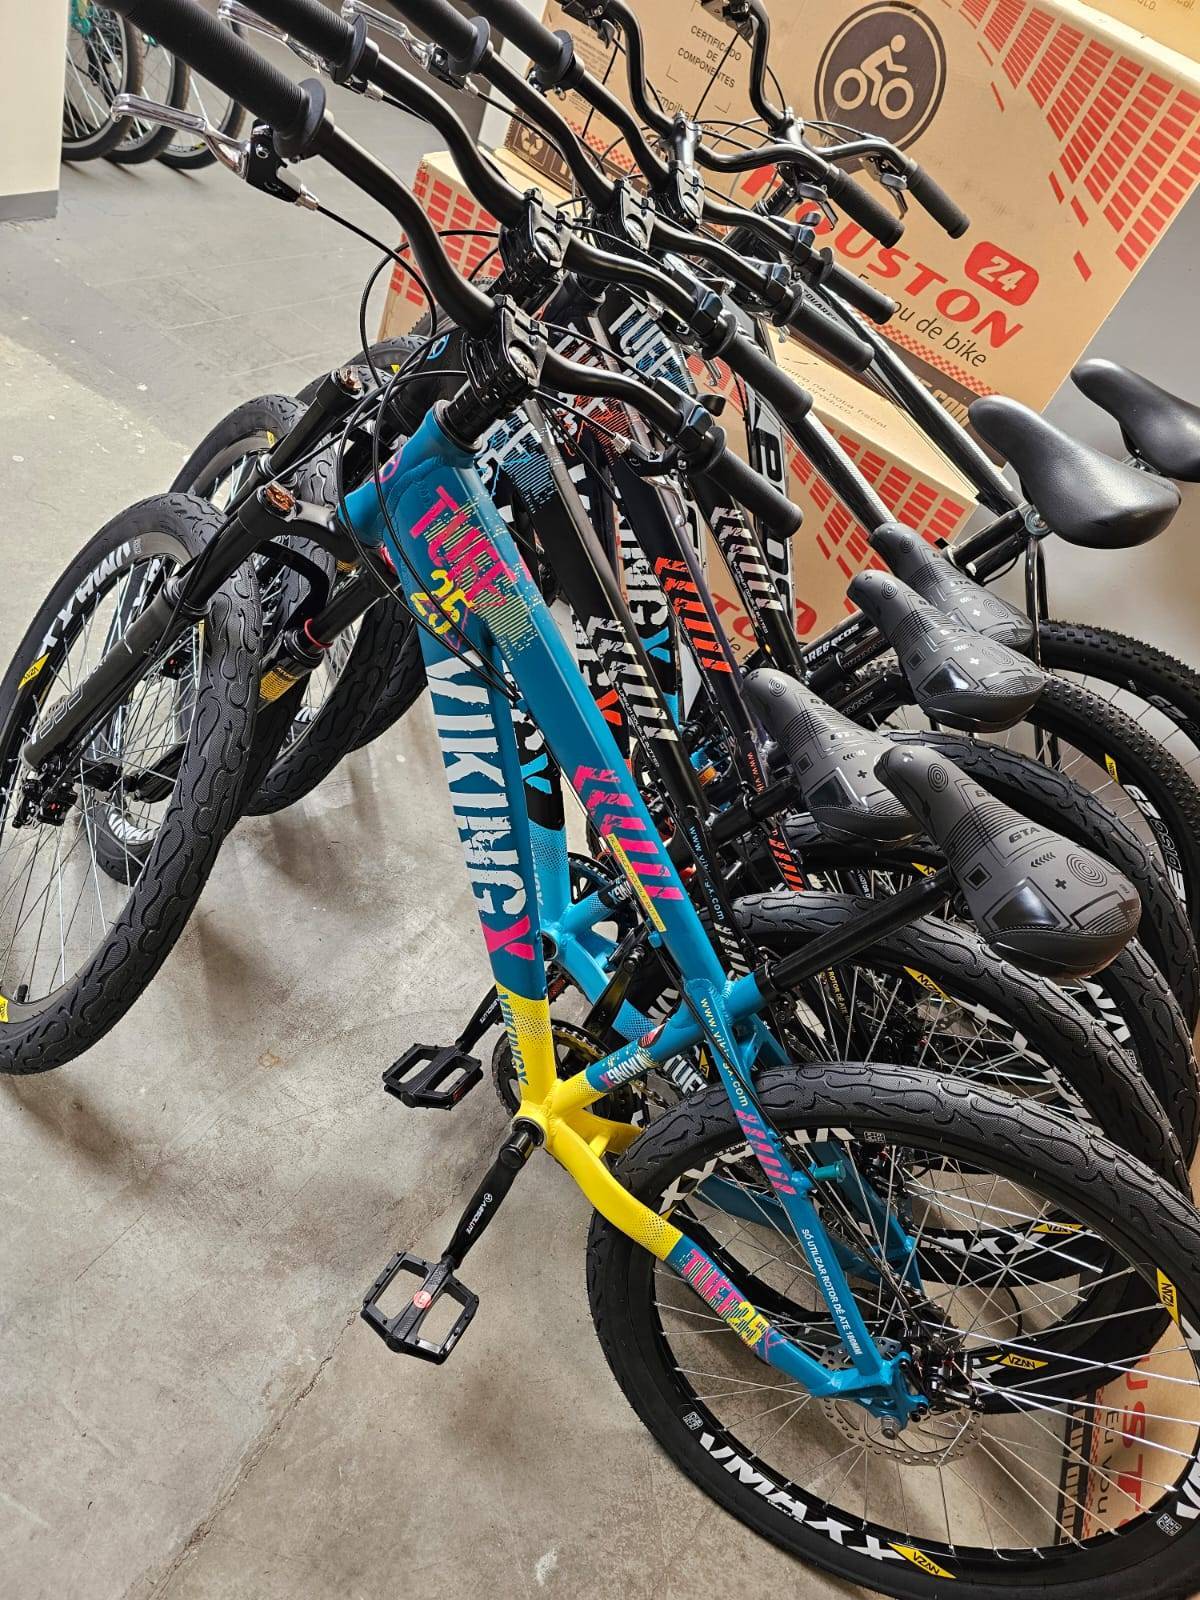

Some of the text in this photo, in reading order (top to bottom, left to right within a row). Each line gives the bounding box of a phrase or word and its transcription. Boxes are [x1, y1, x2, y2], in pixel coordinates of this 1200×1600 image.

[690, 25, 743, 62] CERTIFICDO
[705, 49, 719, 62] DE
[977, 255, 1028, 292] 24
[915, 313, 943, 340] de
[943, 328, 987, 368] bike
[410, 485, 517, 604] TUFF
[37, 541, 131, 660] VMAXX
[410, 569, 475, 635] 25
[427, 650, 535, 960] VIKINGX
[1123, 784, 1161, 820] 29
[1009, 826, 1041, 844] GTA
[683, 1248, 747, 1313] TUFF
[806, 1240, 828, 1274] UTILIZAR
[820, 1274, 839, 1302] ROTOR
[1008, 1356, 1036, 1369] VZAN
[700, 1432, 906, 1561] VMAXX
[913, 1551, 940, 1576] VZAN
